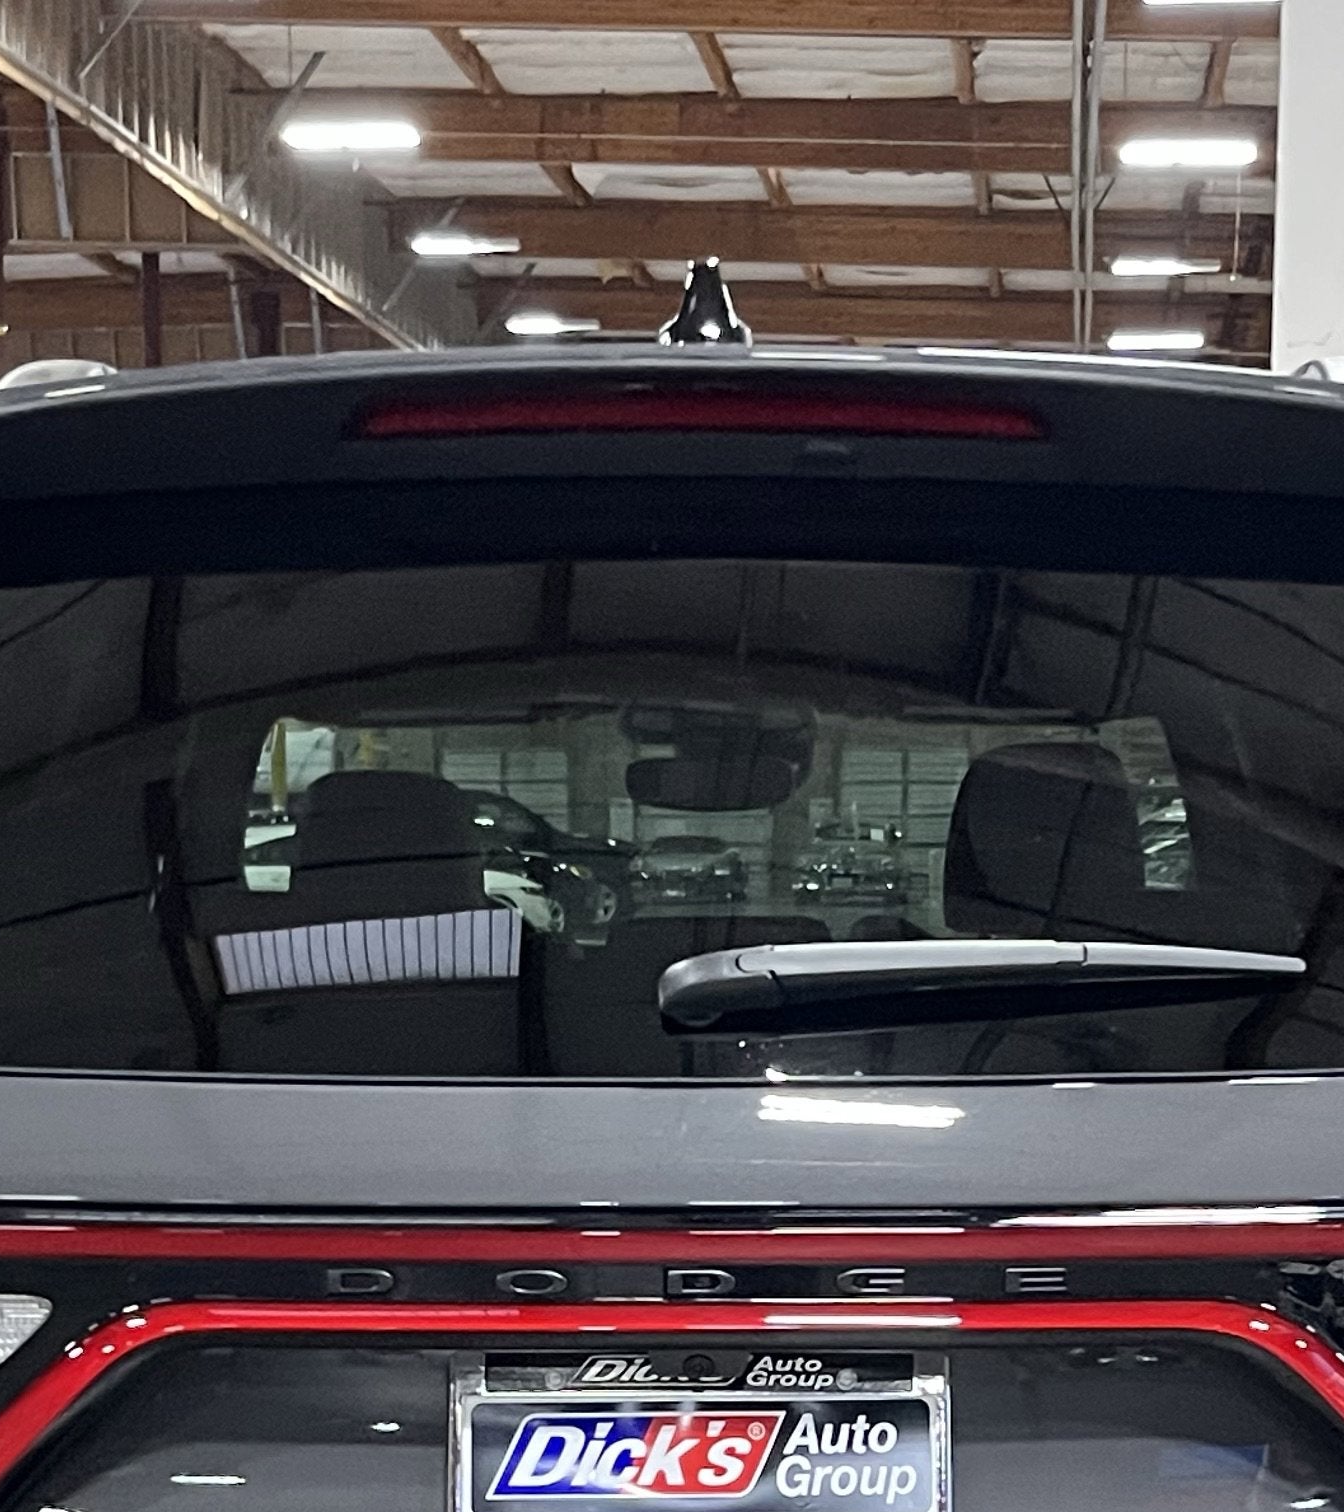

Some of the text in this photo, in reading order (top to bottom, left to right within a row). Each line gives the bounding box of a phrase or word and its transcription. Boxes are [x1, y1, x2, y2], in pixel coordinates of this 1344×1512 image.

[327, 1267, 1068, 1295] DODGE
[753, 1356, 823, 1372] Auto
[746, 1370, 835, 1390] Group
[782, 1413, 898, 1454] Auto
[775, 1454, 918, 1504] Group
